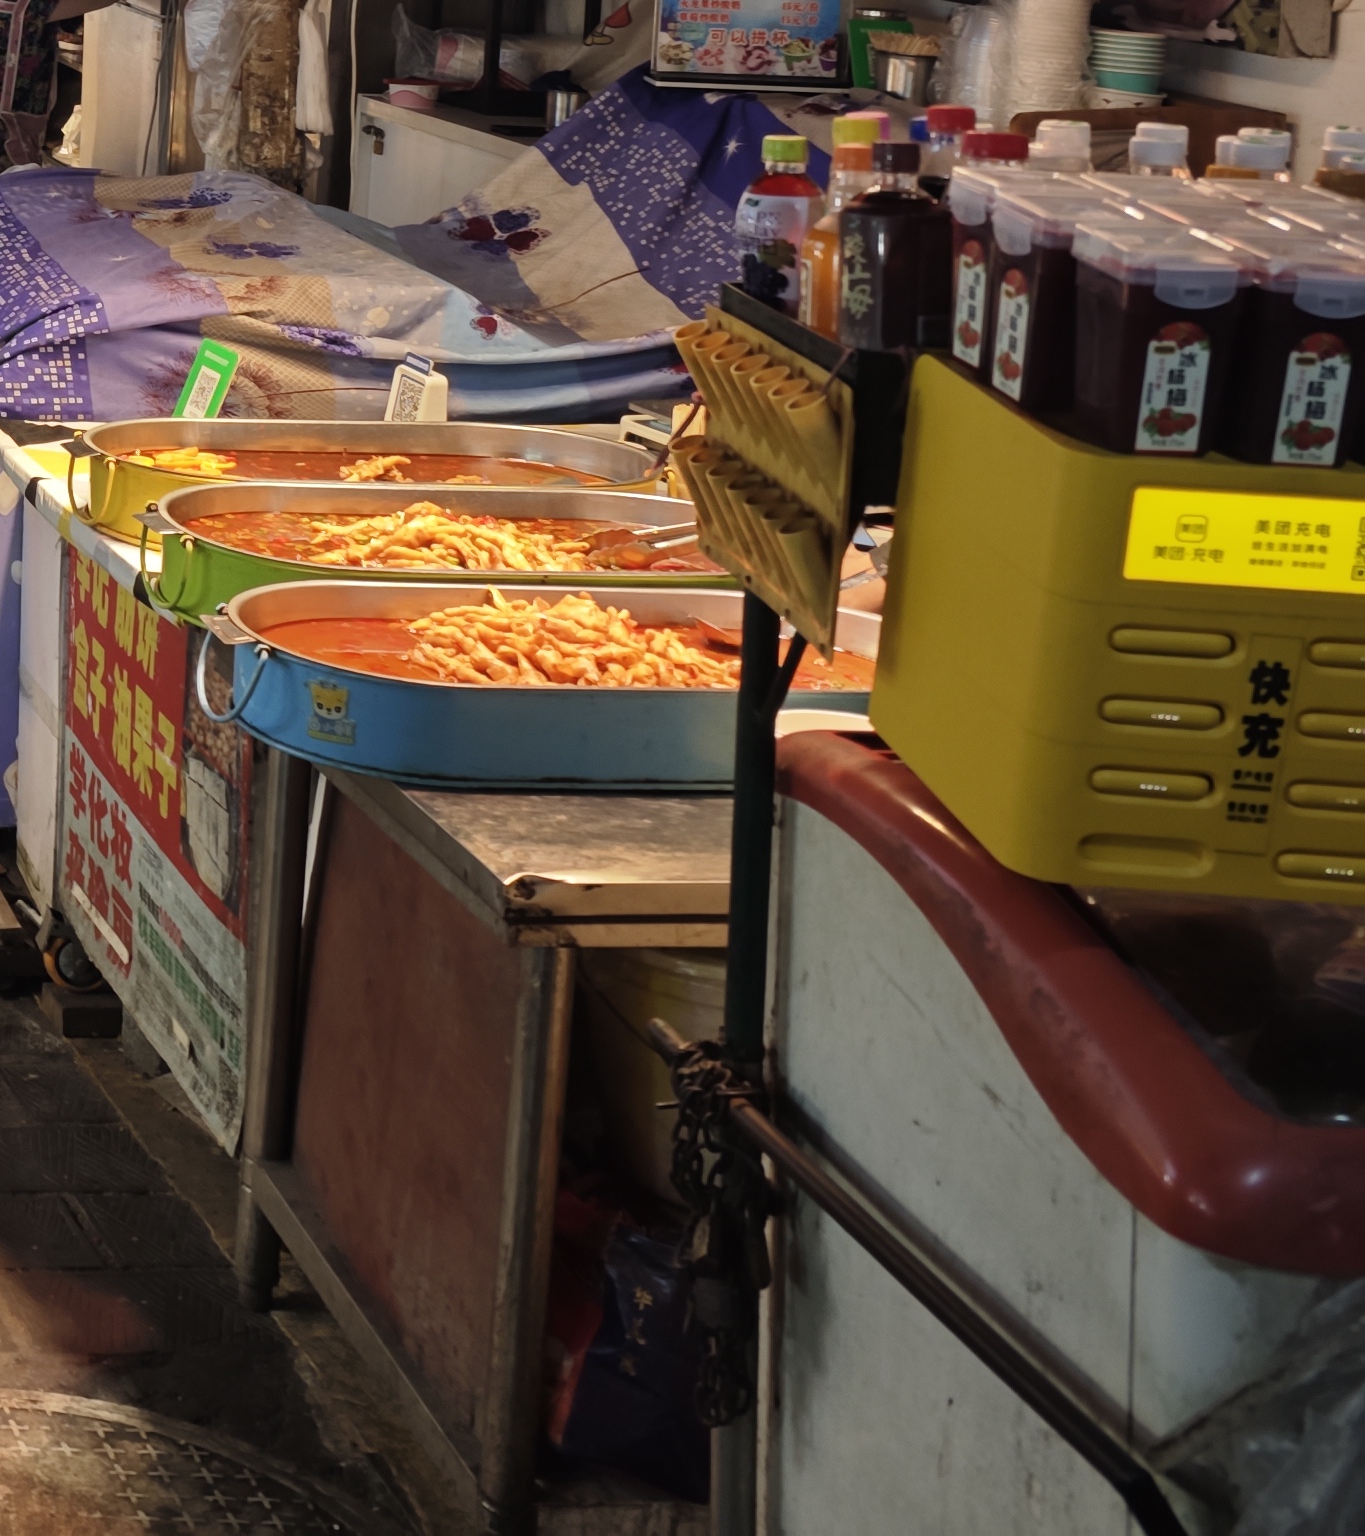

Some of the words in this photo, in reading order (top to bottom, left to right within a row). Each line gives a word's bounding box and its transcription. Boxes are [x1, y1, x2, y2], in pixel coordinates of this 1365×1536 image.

[709, 29, 790, 46] 可以拼杯
[1254, 519, 1332, 538] 美团充电
[1238, 660, 1292, 760] 快充
